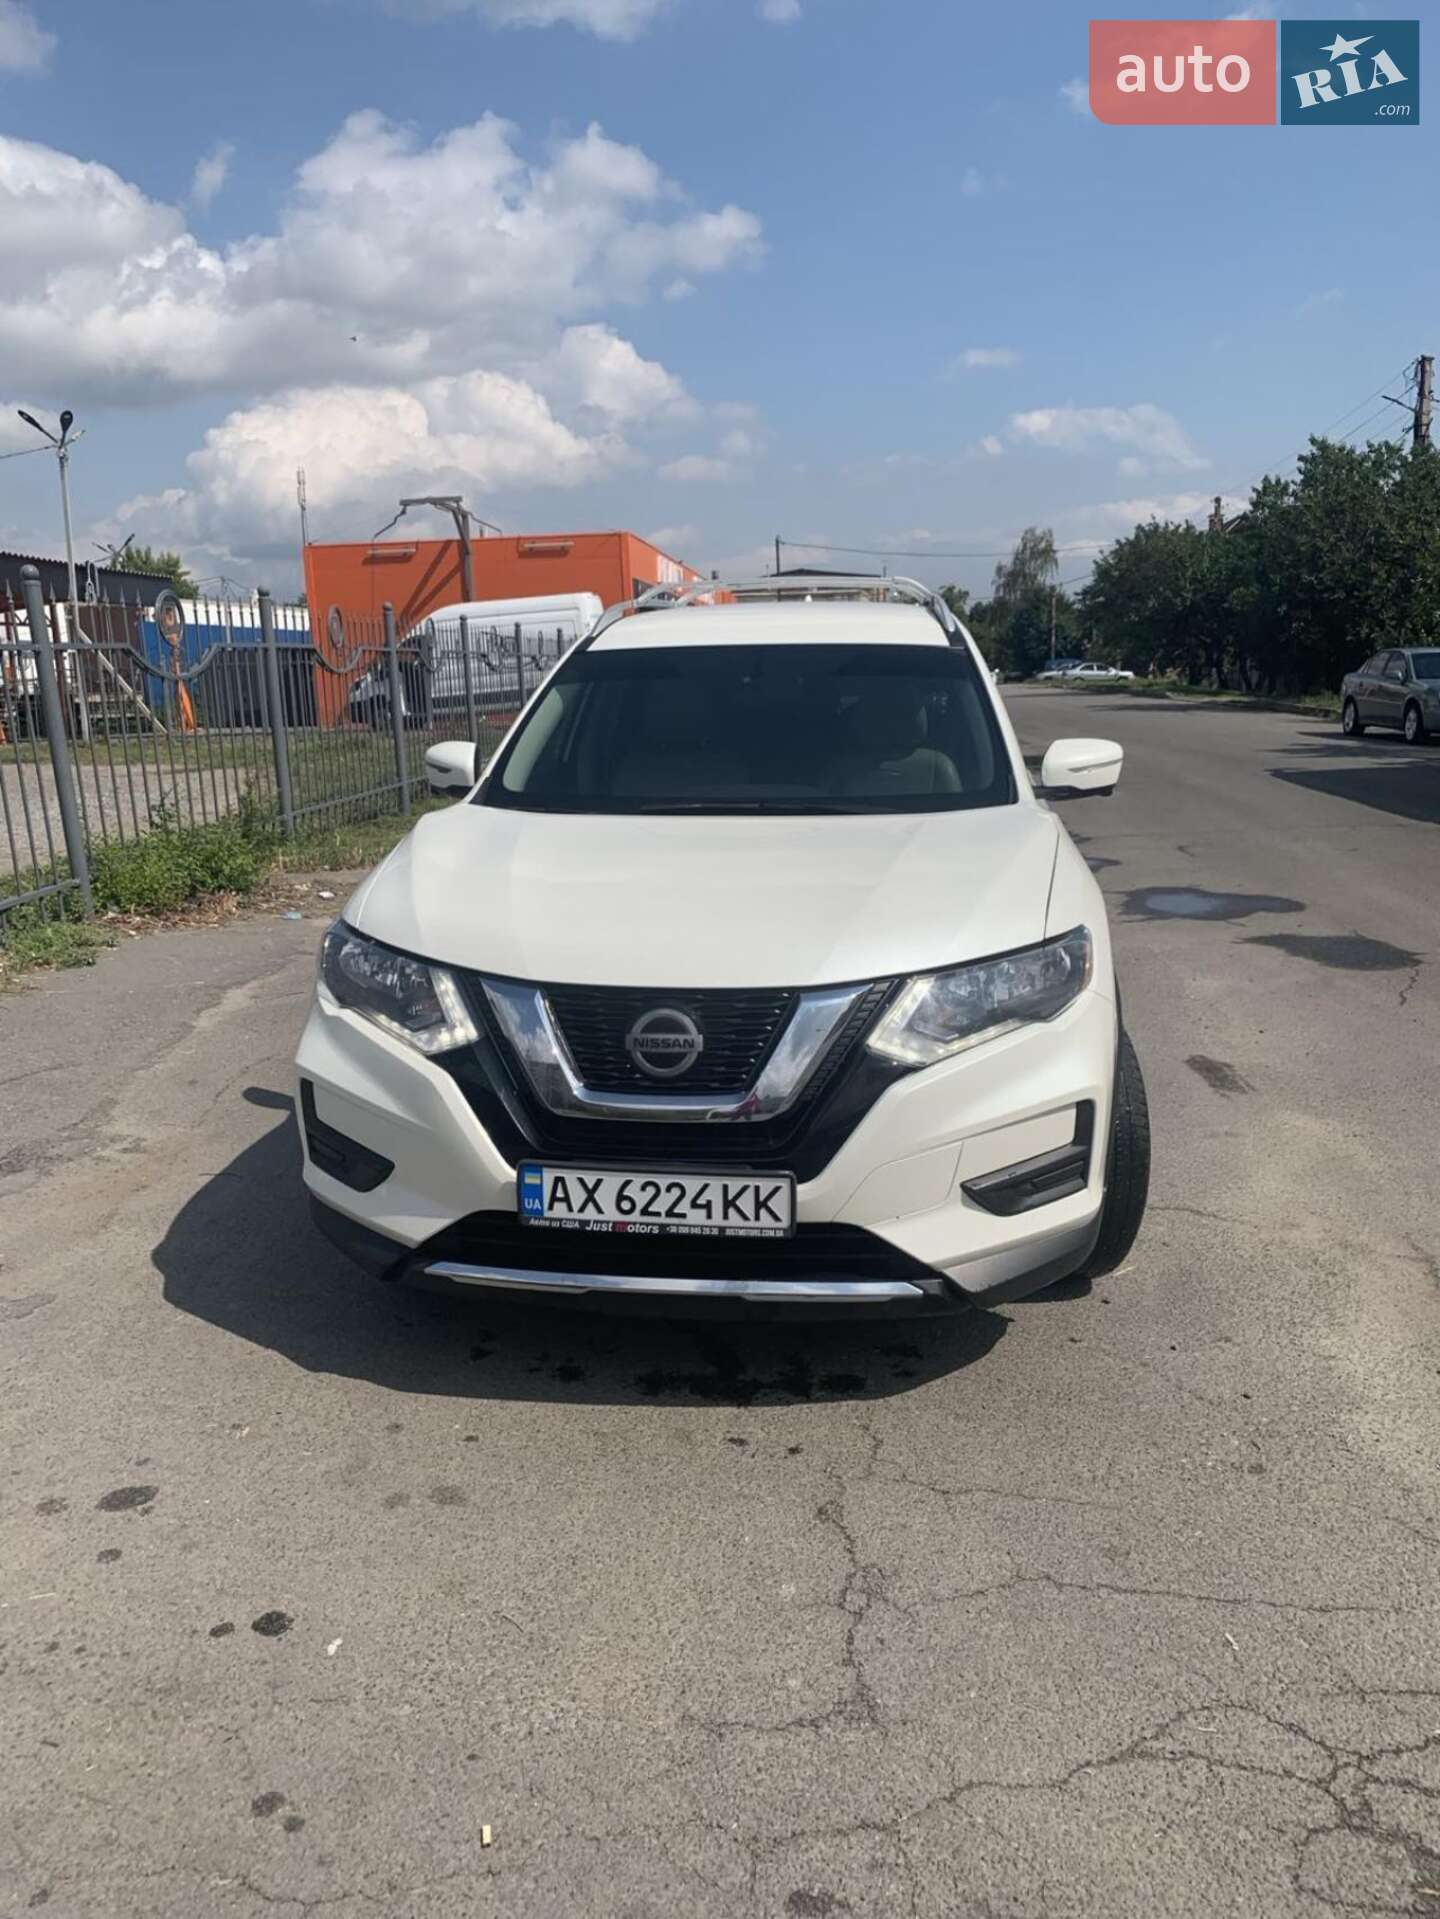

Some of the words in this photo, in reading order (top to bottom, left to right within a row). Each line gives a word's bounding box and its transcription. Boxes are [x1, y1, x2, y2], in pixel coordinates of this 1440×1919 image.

[633, 1037, 695, 1049] NISSAN
[547, 1176, 605, 1215] AX
[524, 1198, 542, 1210] UA
[585, 1219, 613, 1232] Just
